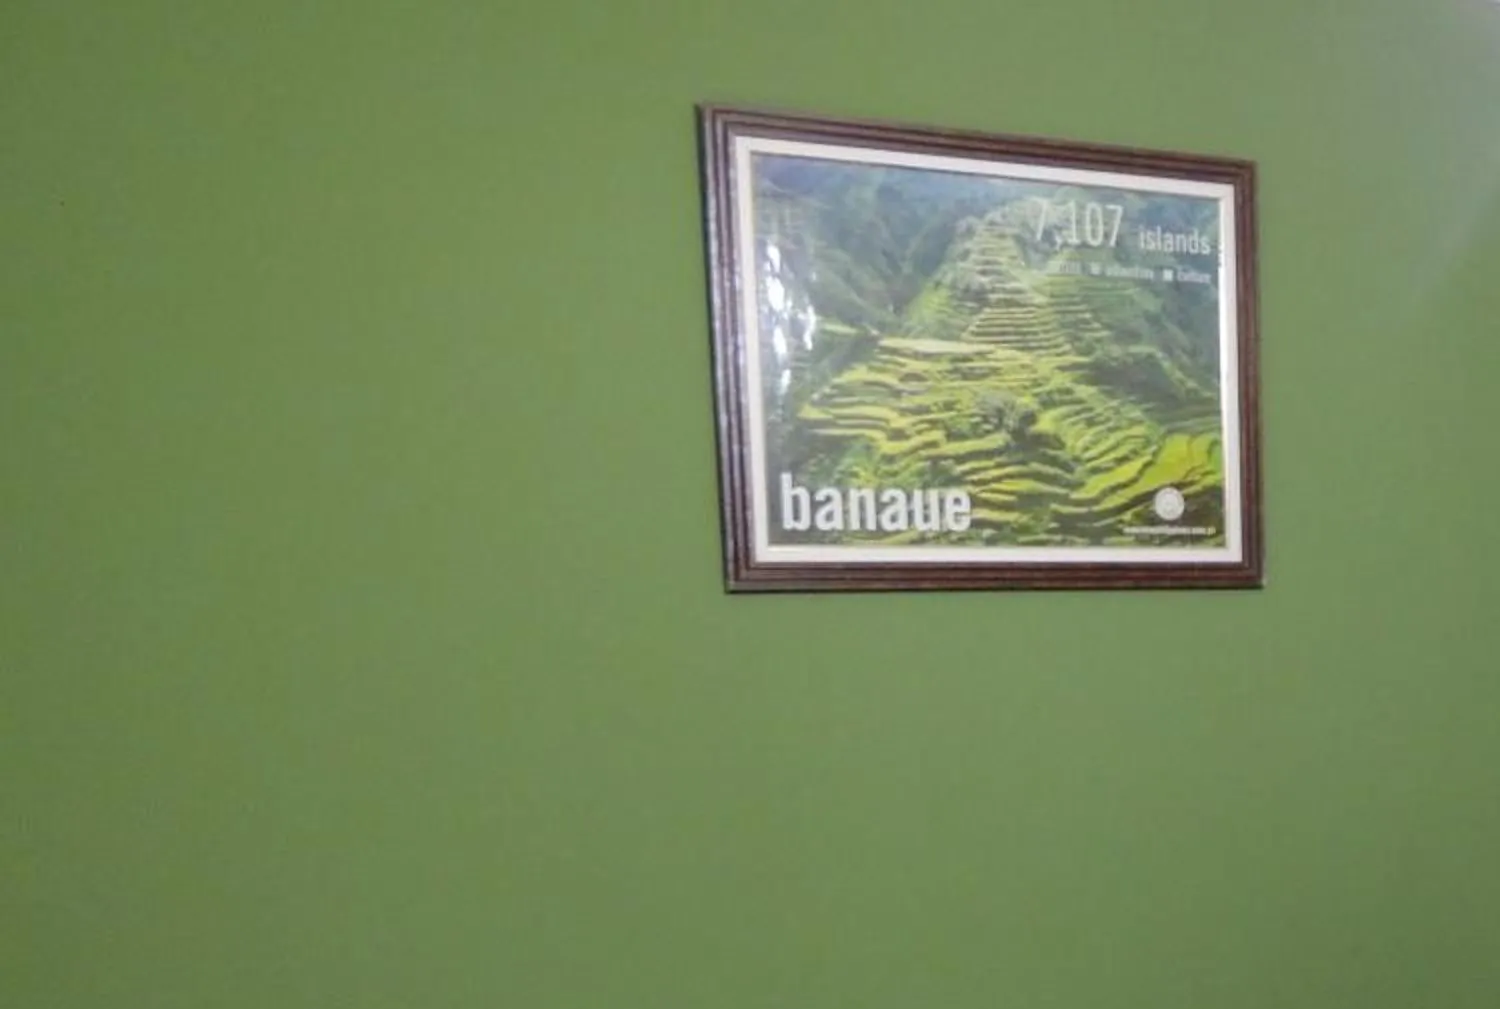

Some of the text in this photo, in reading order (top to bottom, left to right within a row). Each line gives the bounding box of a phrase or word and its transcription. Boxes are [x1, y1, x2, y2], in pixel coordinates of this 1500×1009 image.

[1031, 198, 1211, 255] 7,107 islands
[780, 472, 972, 532] banaue
